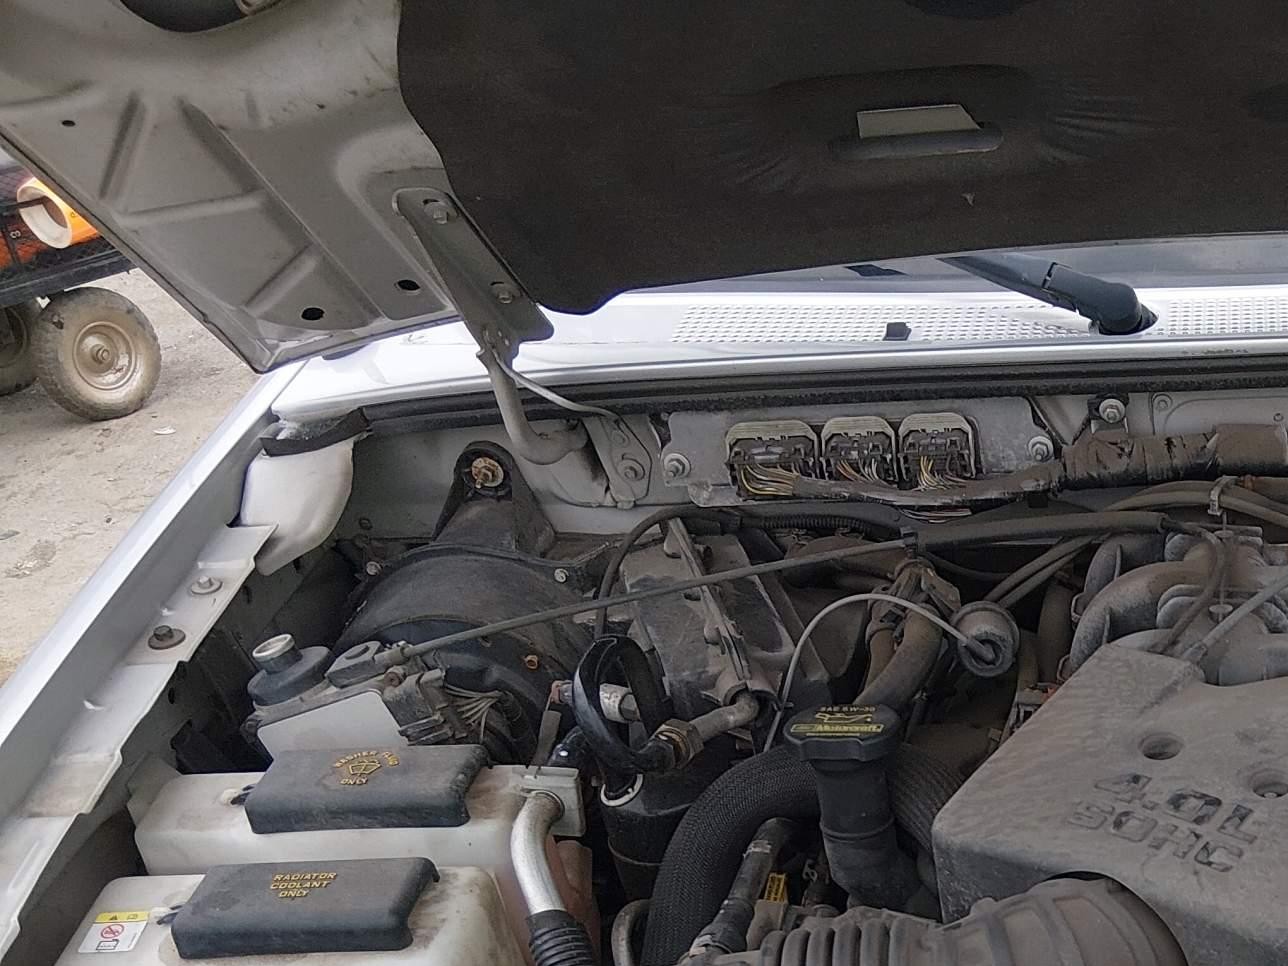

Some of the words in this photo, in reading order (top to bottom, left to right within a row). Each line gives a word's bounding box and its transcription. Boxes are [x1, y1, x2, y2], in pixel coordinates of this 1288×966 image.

[340, 777, 368, 785] ONLY
[1095, 773, 1257, 844] 4.0L
[1068, 801, 1243, 872] SOHC
[270, 881, 330, 889] COOLANT
